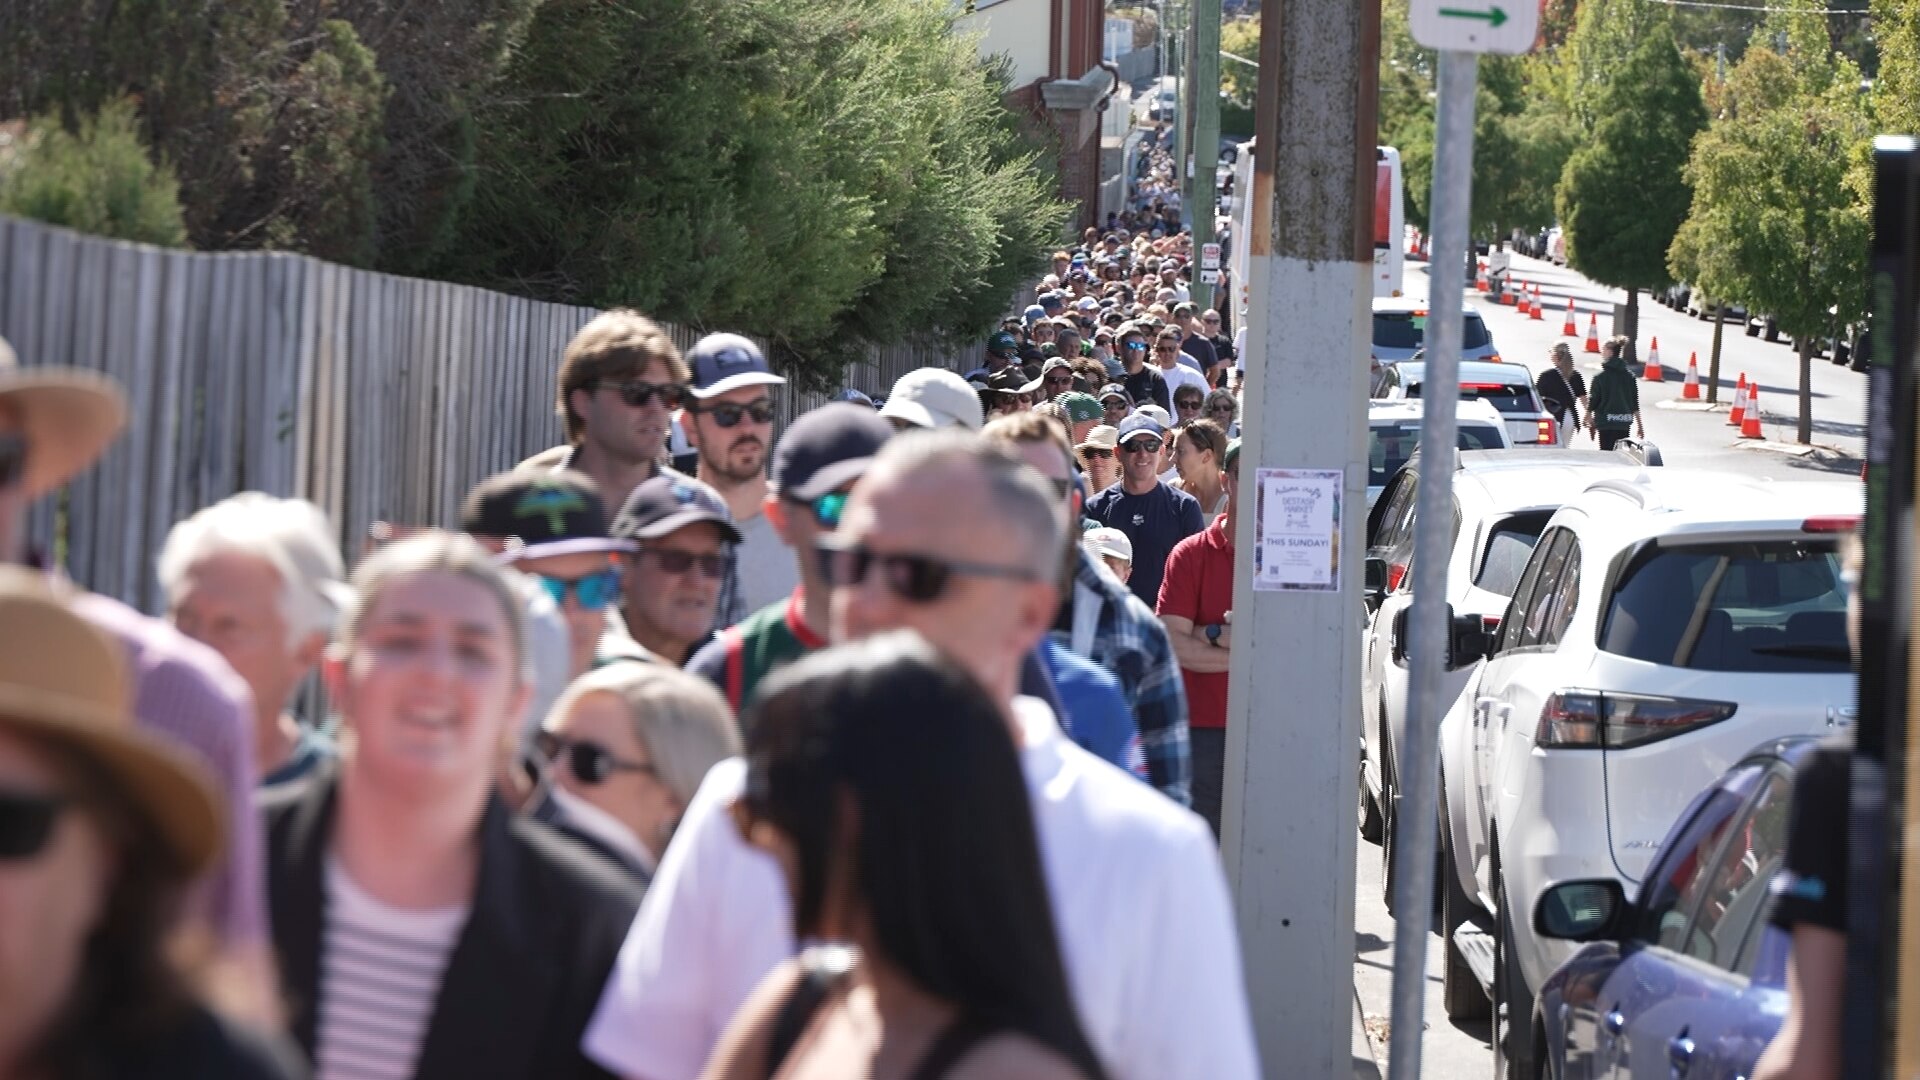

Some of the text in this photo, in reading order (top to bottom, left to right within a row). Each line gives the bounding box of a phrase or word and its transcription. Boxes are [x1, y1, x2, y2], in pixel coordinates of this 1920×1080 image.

[1284, 505, 1313, 513] MARKET
[1266, 538, 1329, 548] THIS SUNDAY!
